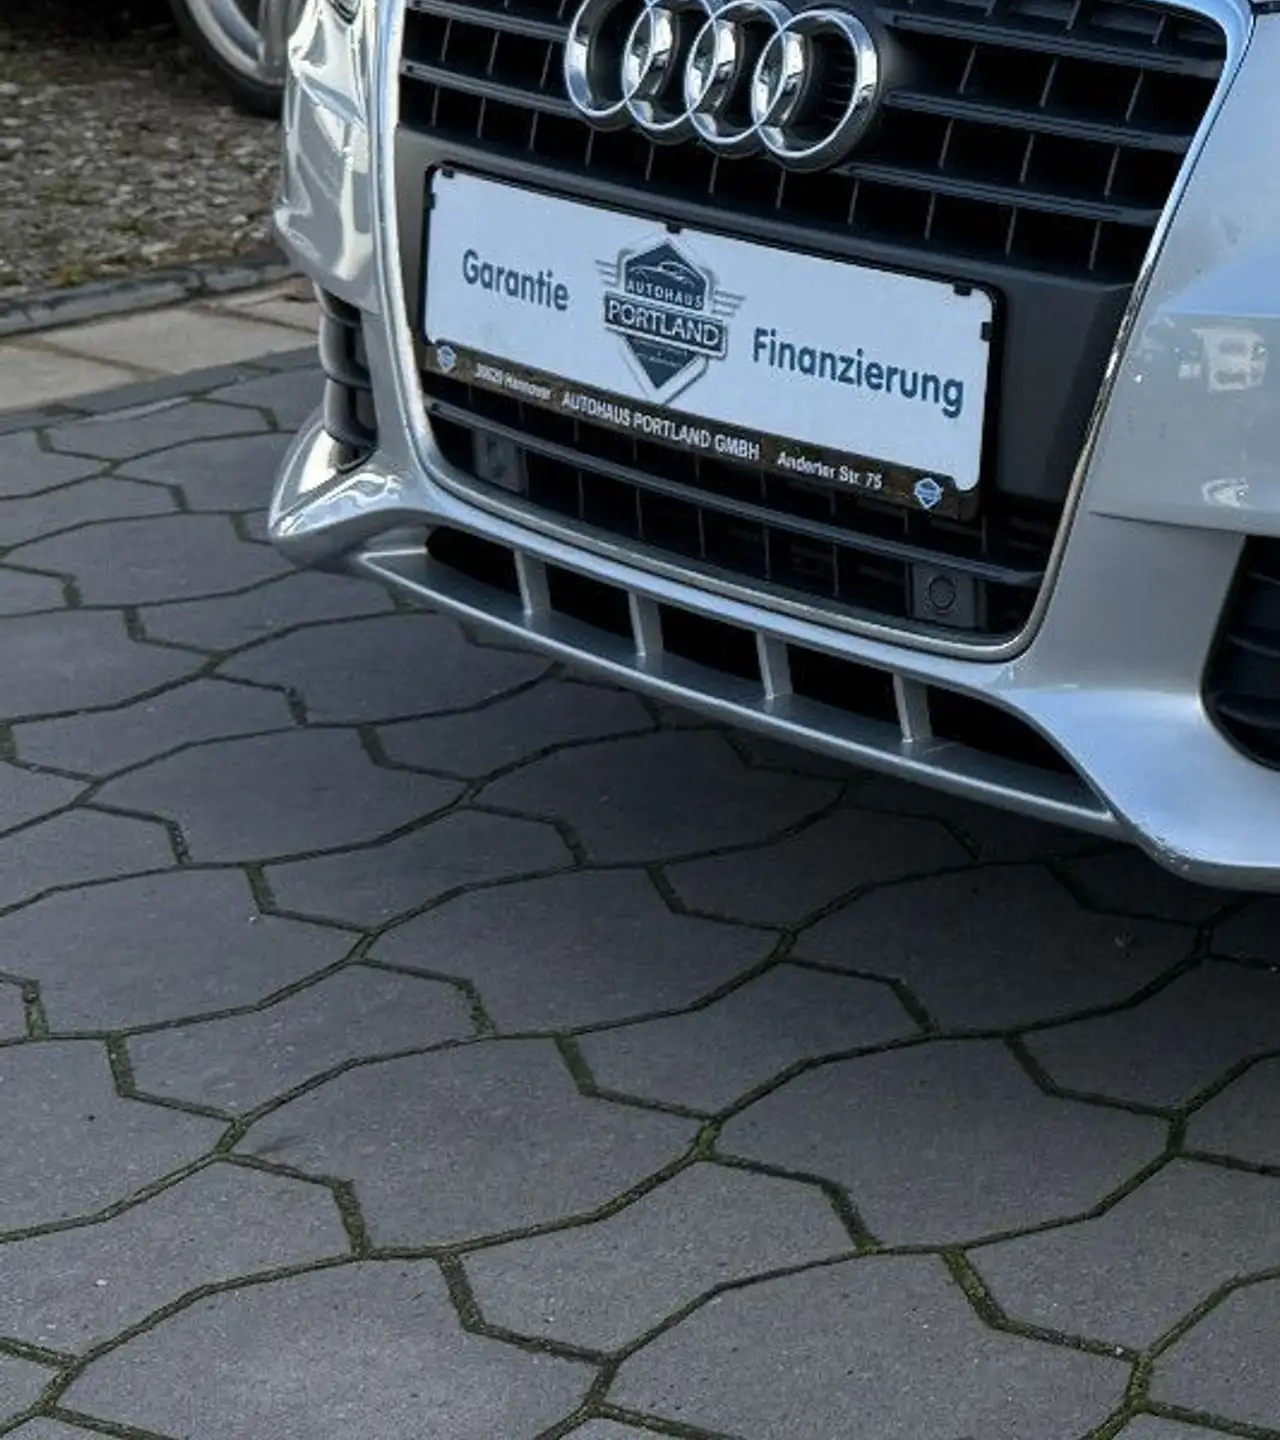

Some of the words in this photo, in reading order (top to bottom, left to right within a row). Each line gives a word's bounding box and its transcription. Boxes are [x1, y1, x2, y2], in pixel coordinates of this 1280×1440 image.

[463, 248, 569, 311] Garantie
[626, 279, 704, 309] AUTOHAUS
[608, 299, 720, 347] PORTLAND
[753, 326, 964, 419] Finanzierung
[561, 391, 632, 427] AUTOHAUS
[633, 411, 710, 448] PORTLAND
[714, 434, 760, 460] GMBH
[865, 472, 883, 490] 75
